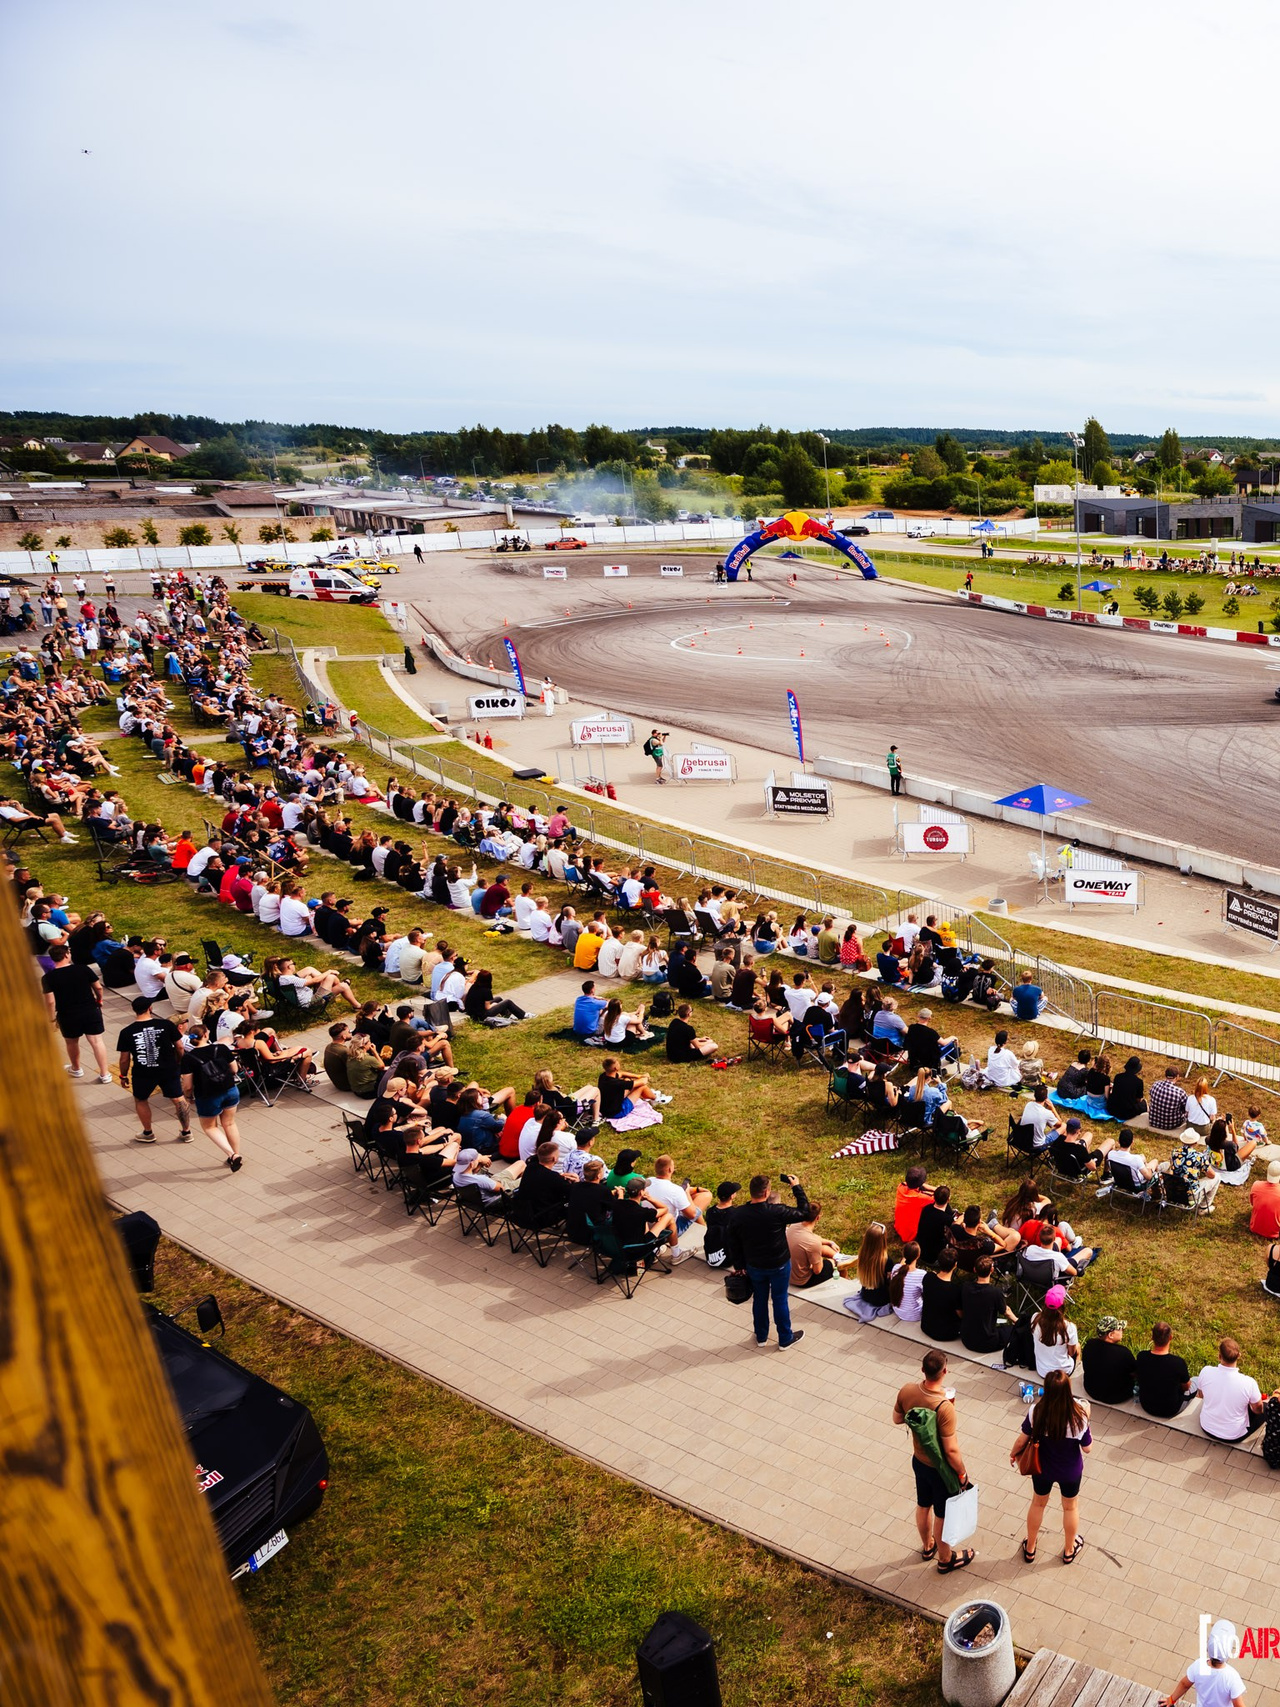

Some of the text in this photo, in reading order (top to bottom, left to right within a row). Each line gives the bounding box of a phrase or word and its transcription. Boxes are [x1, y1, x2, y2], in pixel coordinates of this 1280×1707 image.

[585, 724, 625, 733] bebrusai
[686, 758, 727, 767] bebrusai
[789, 791, 826, 799] MOLSETOS
[1243, 902, 1278, 920] MOLSETOS
[1243, 908, 1273, 925] PREKYBA
[708, 1248, 725, 1263] NIKE
